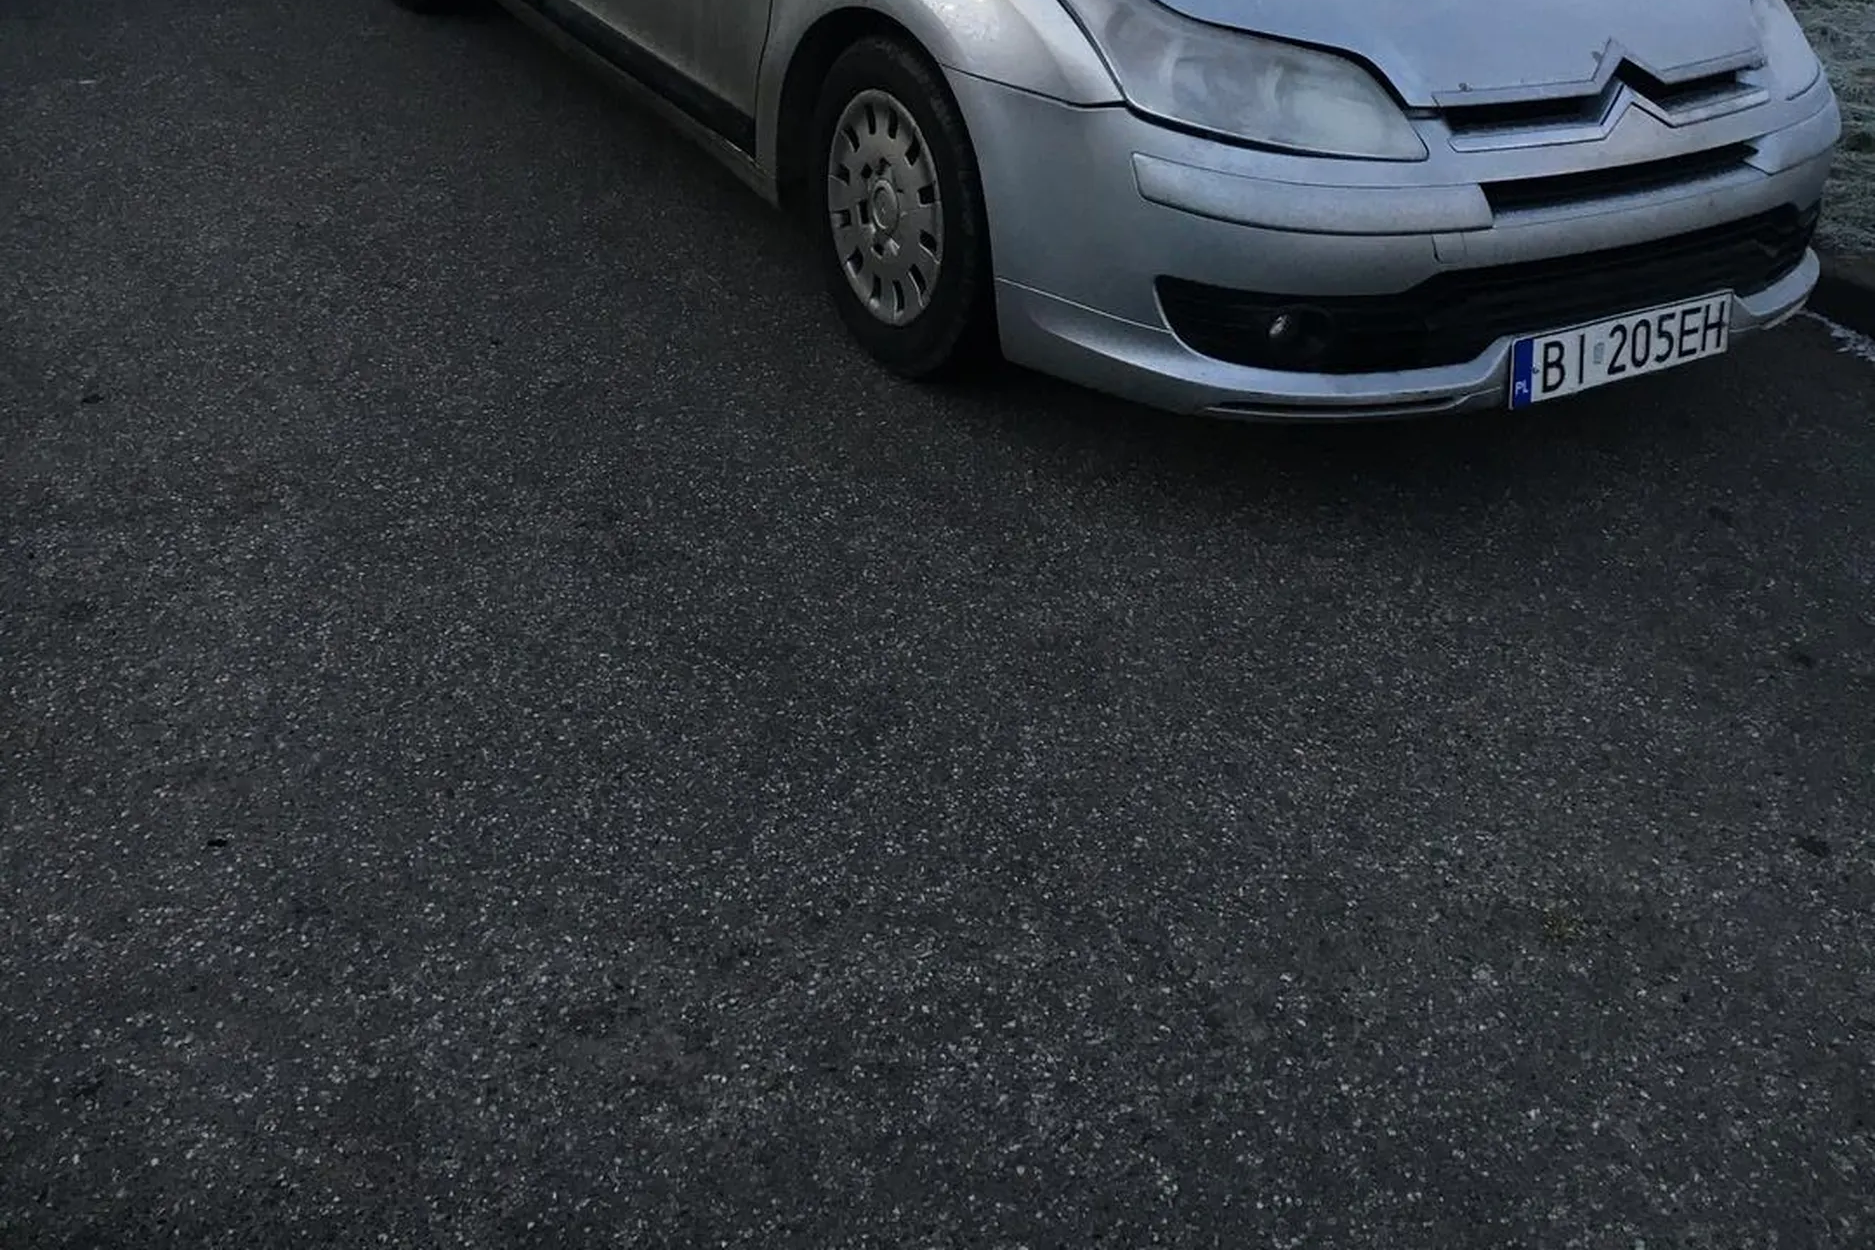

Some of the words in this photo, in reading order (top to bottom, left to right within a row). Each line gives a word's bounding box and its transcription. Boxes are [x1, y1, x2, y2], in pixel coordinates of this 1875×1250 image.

[1542, 334, 1585, 393] BI
[1608, 301, 1725, 375] 205EH
[1515, 379, 1529, 396] PL
